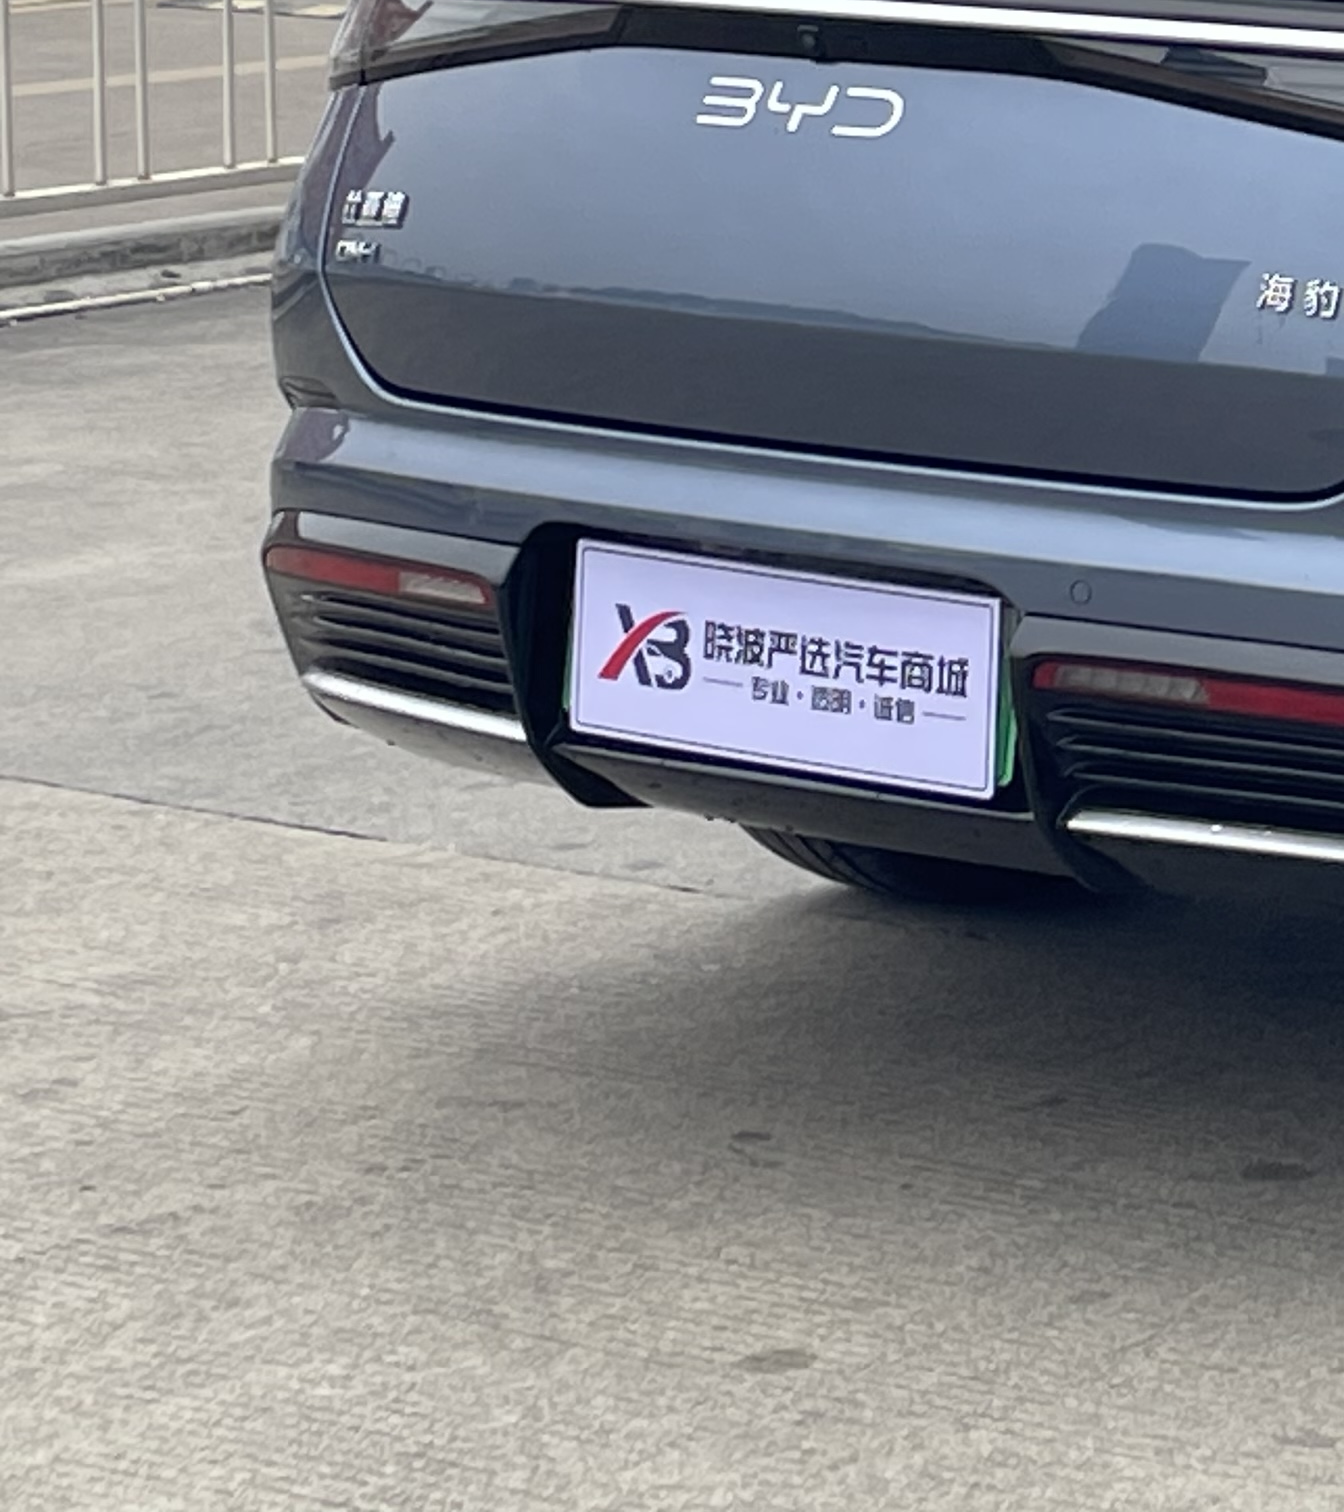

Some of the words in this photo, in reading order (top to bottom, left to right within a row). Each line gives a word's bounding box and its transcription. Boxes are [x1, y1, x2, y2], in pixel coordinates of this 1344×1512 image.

[696, 75, 905, 138] BYD
[702, 619, 970, 699] 晓波严选汽车商城
